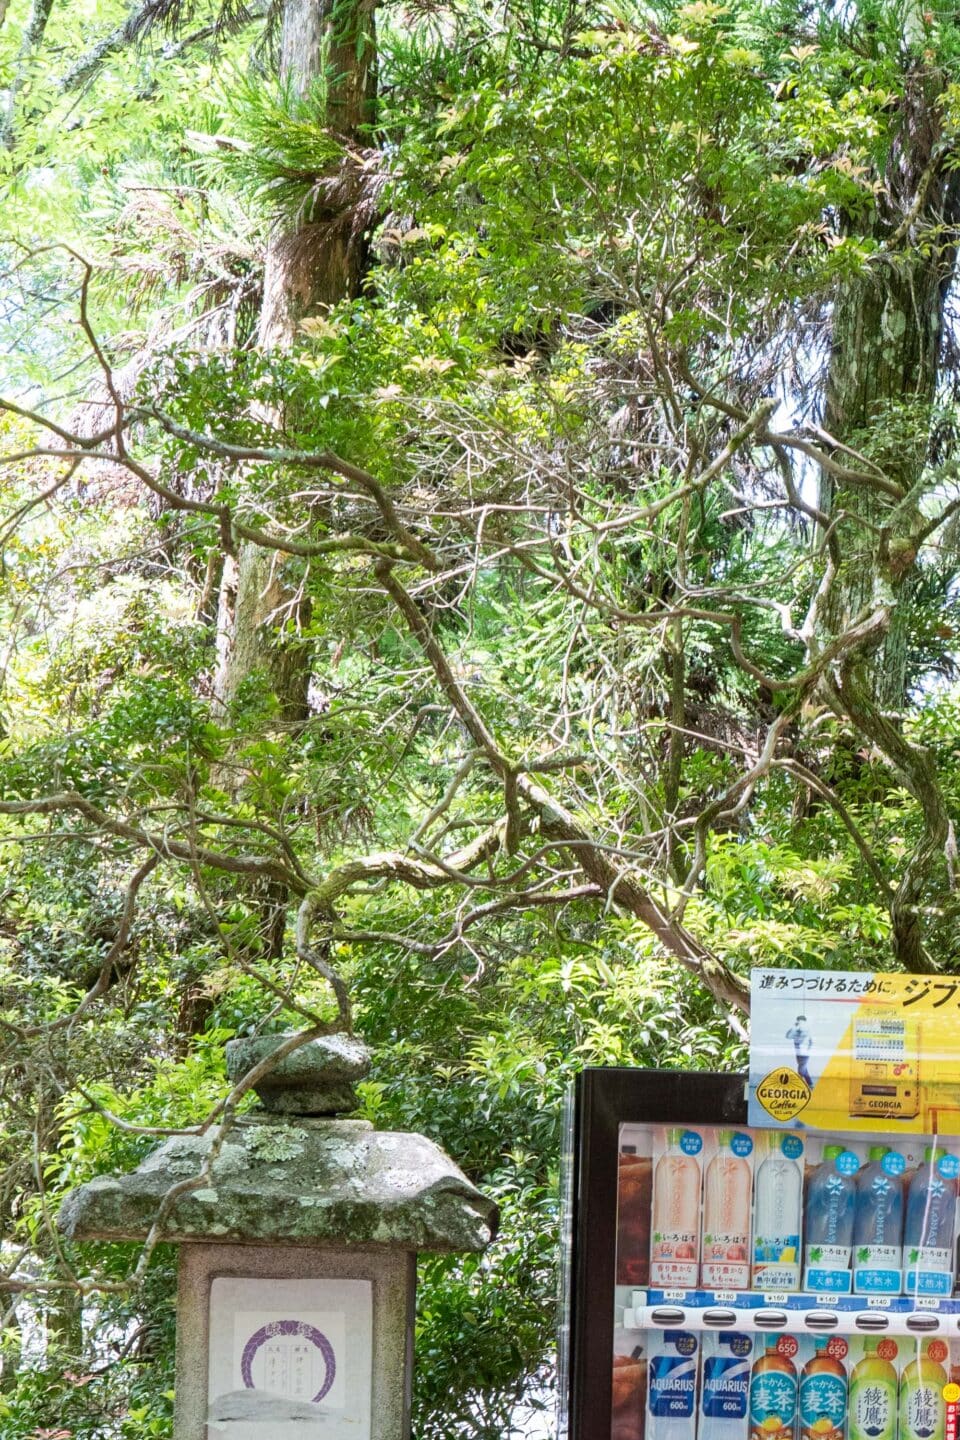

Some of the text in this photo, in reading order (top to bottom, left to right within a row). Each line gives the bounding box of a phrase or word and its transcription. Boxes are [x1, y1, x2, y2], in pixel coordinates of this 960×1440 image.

[759, 974, 896, 995] 進みつづけるために。
[760, 1088, 807, 1100] GEORGIA
[769, 1100, 797, 1110] Coffee
[869, 1101, 902, 1109] GEORGIA
[815, 1276, 844, 1287] 天然水
[865, 1275, 893, 1287] 天然水
[916, 1277, 944, 1289] 天然水
[778, 1344, 796, 1353] 650
[828, 1345, 847, 1354] 650
[650, 1378, 694, 1391] AQUARIUS
[704, 1379, 748, 1393] AQUARIUS
[752, 1387, 793, 1411] 麦茶
[803, 1389, 844, 1413] 麦茶
[863, 1387, 883, 1426] 綾鷹
[914, 1388, 934, 1427] 綾鷹
